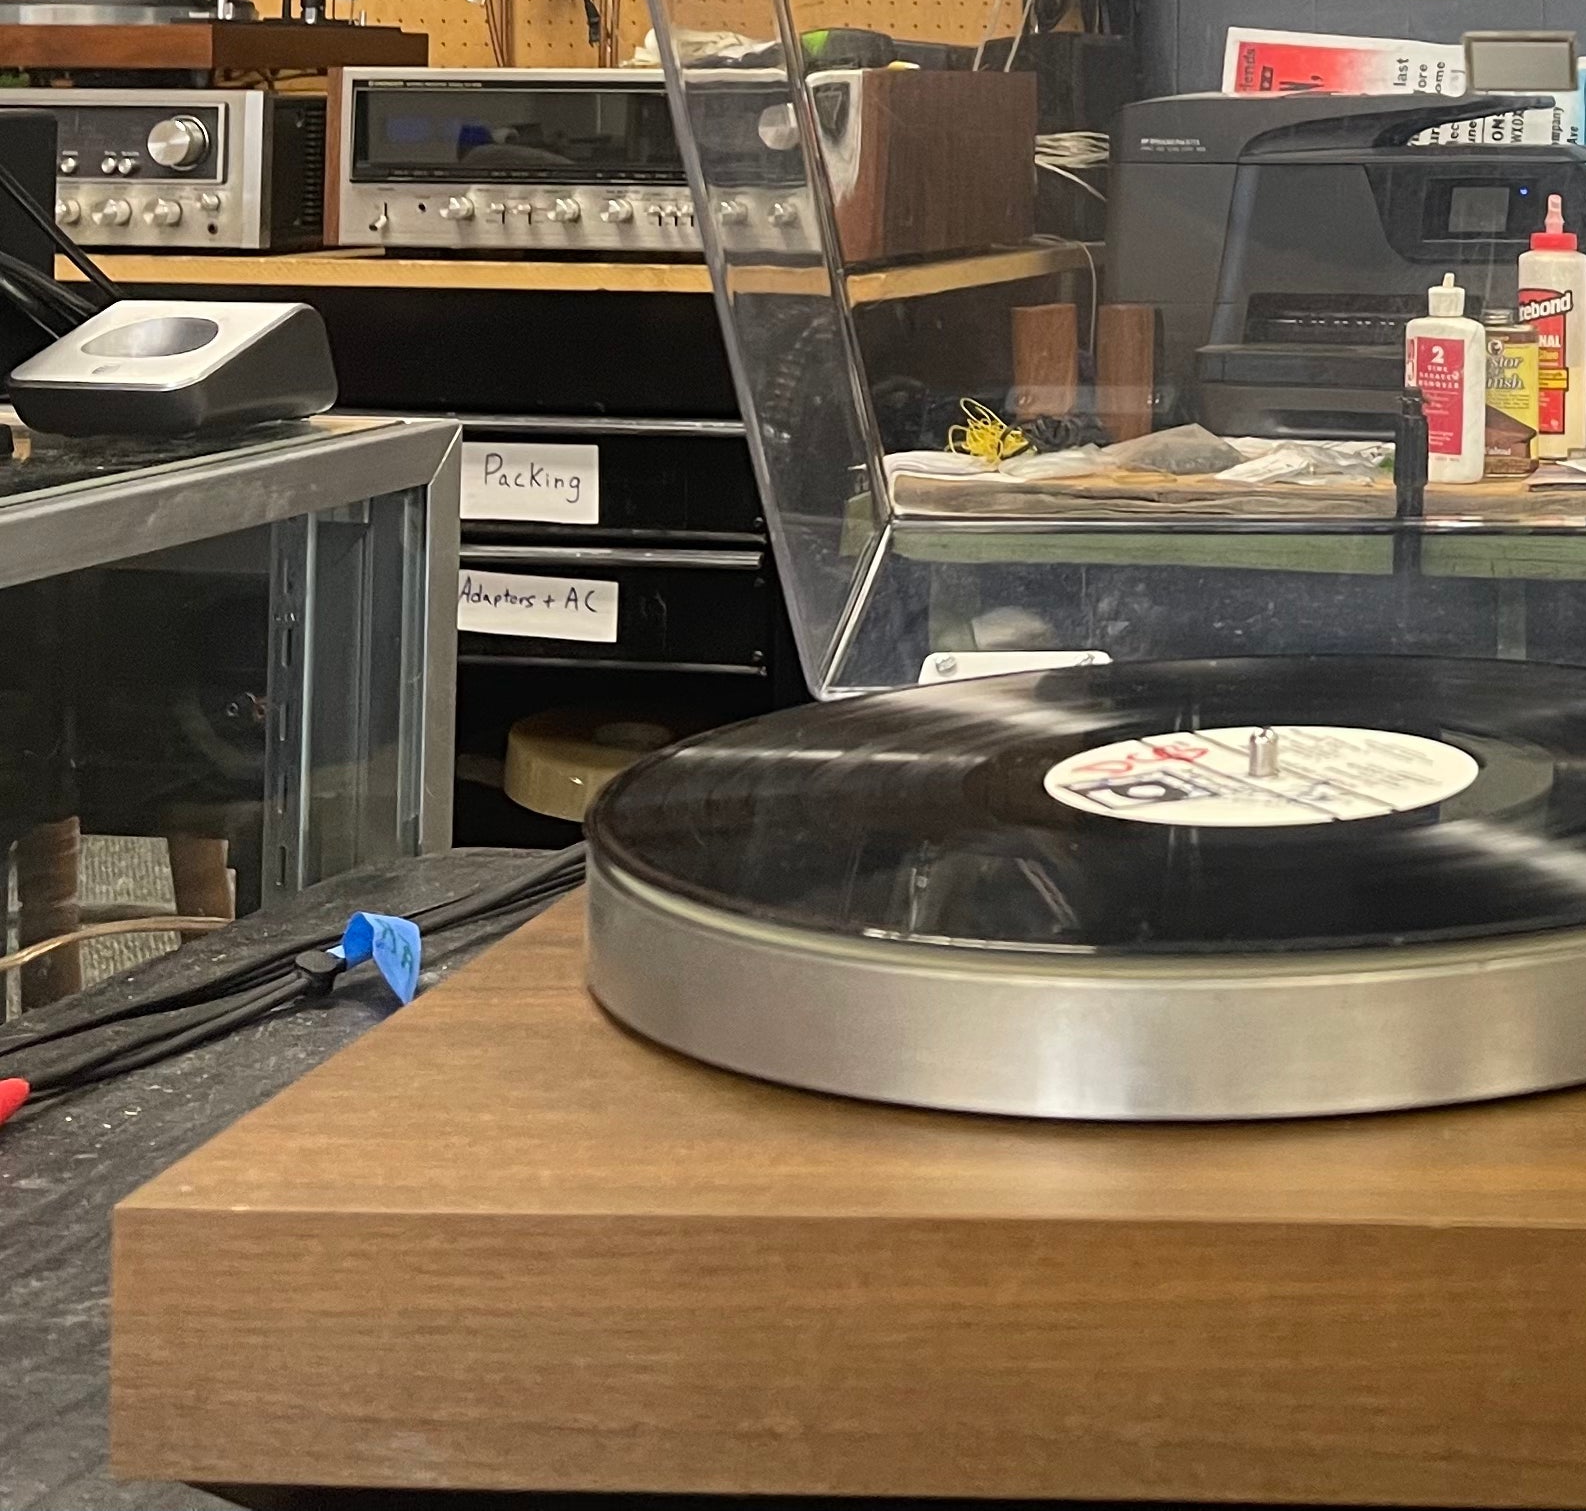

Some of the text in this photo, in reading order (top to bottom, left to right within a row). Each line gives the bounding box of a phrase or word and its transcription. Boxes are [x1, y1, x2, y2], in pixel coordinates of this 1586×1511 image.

[1393, 57, 1410, 88] last
[1431, 345, 1445, 364] 2
[459, 576, 537, 609] Adapters
